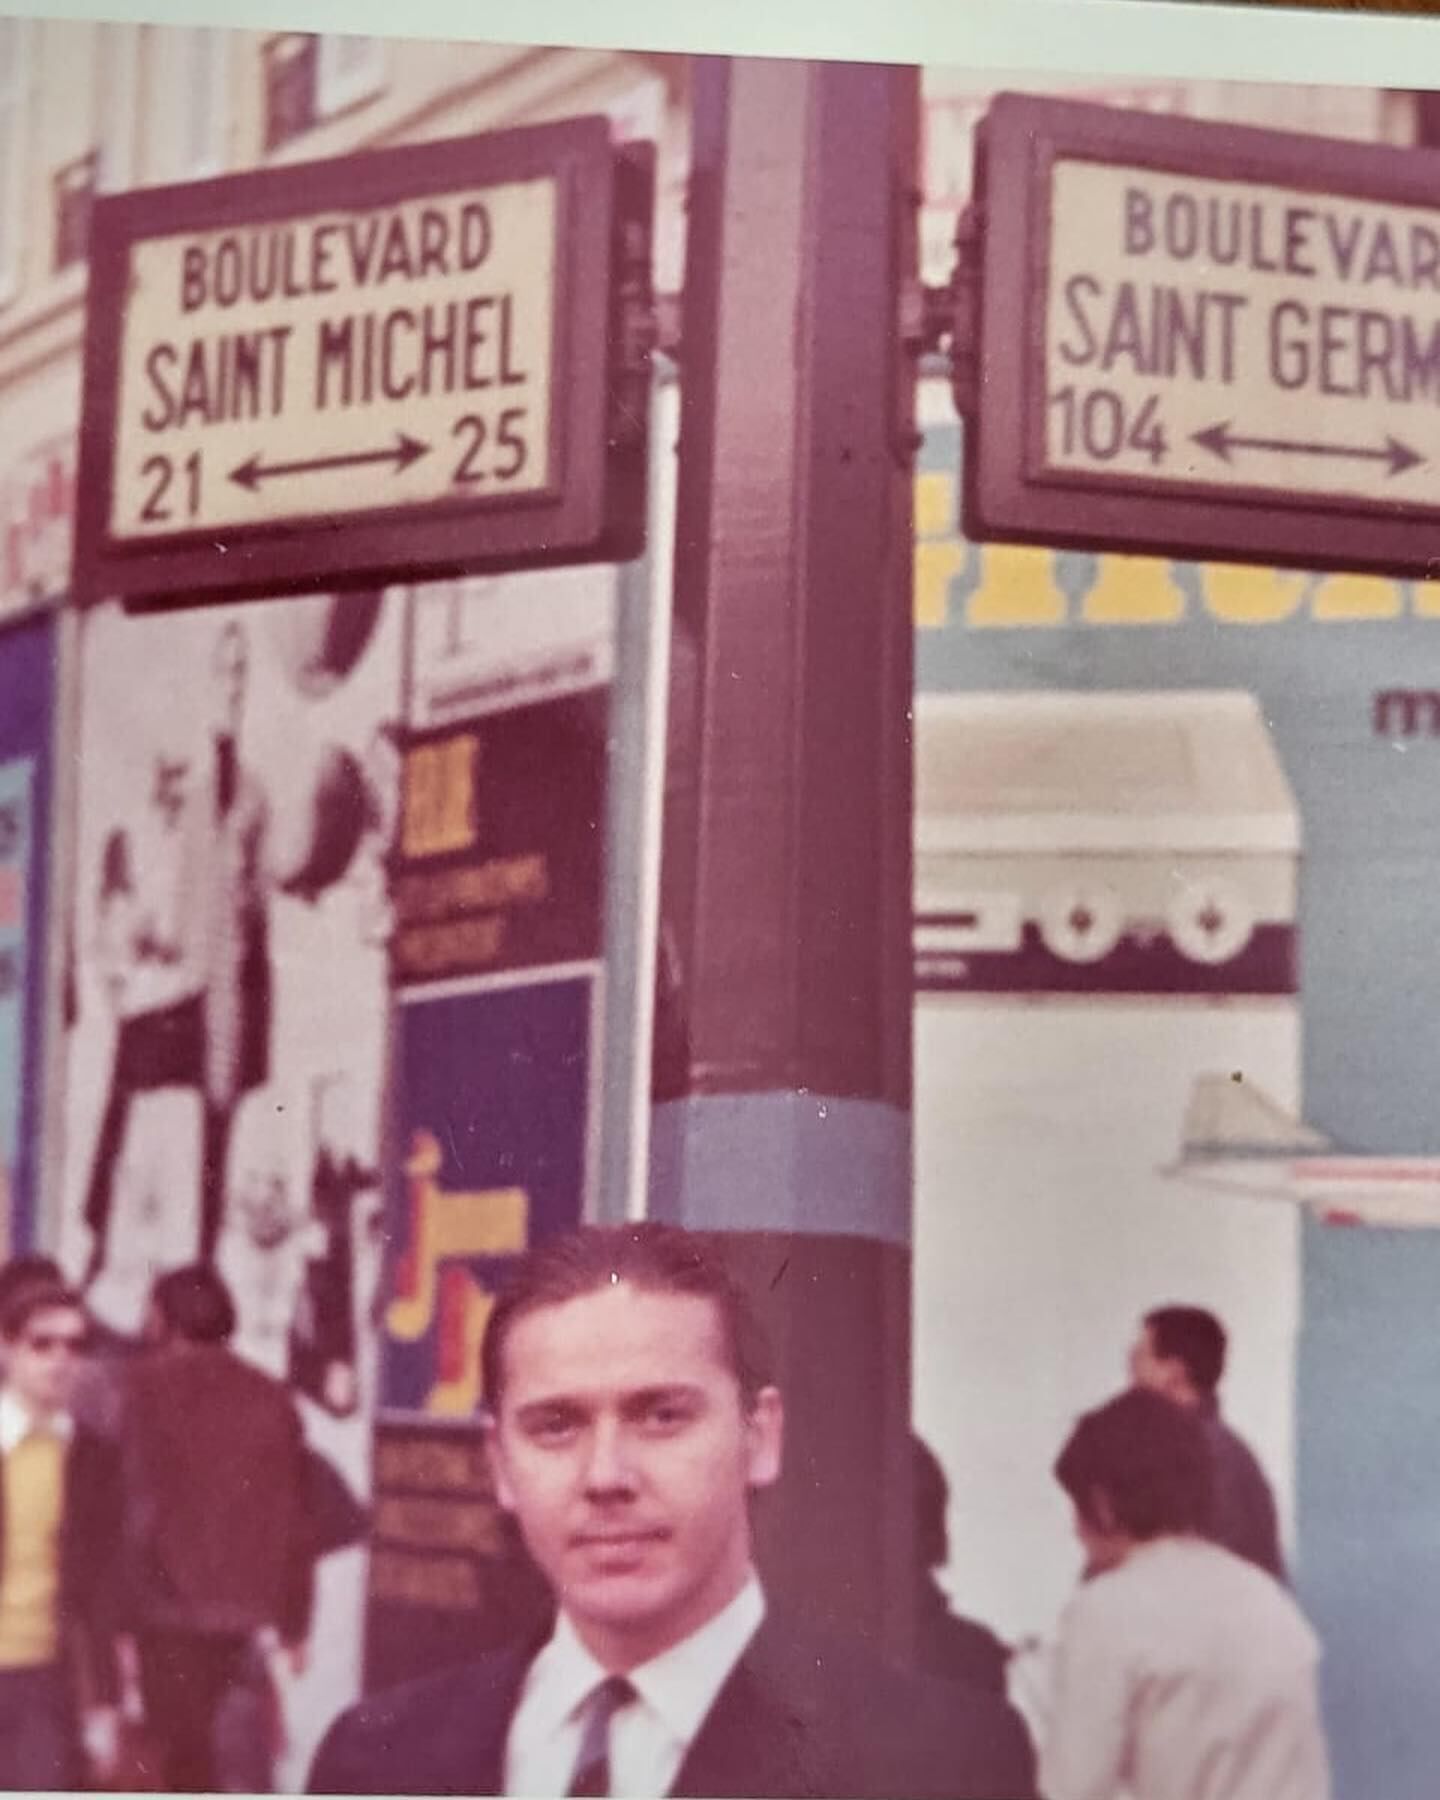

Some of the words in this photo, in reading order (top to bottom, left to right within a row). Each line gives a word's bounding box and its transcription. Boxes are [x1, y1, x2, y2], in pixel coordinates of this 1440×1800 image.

[180, 201, 492, 314] BOULEVARD
[141, 324, 293, 434] SAINT
[314, 293, 527, 410] MICHEL
[1058, 273, 1250, 384] SAINT
[138, 449, 203, 523] 21
[451, 408, 529, 485] 25
[1050, 385, 1171, 466] 104
